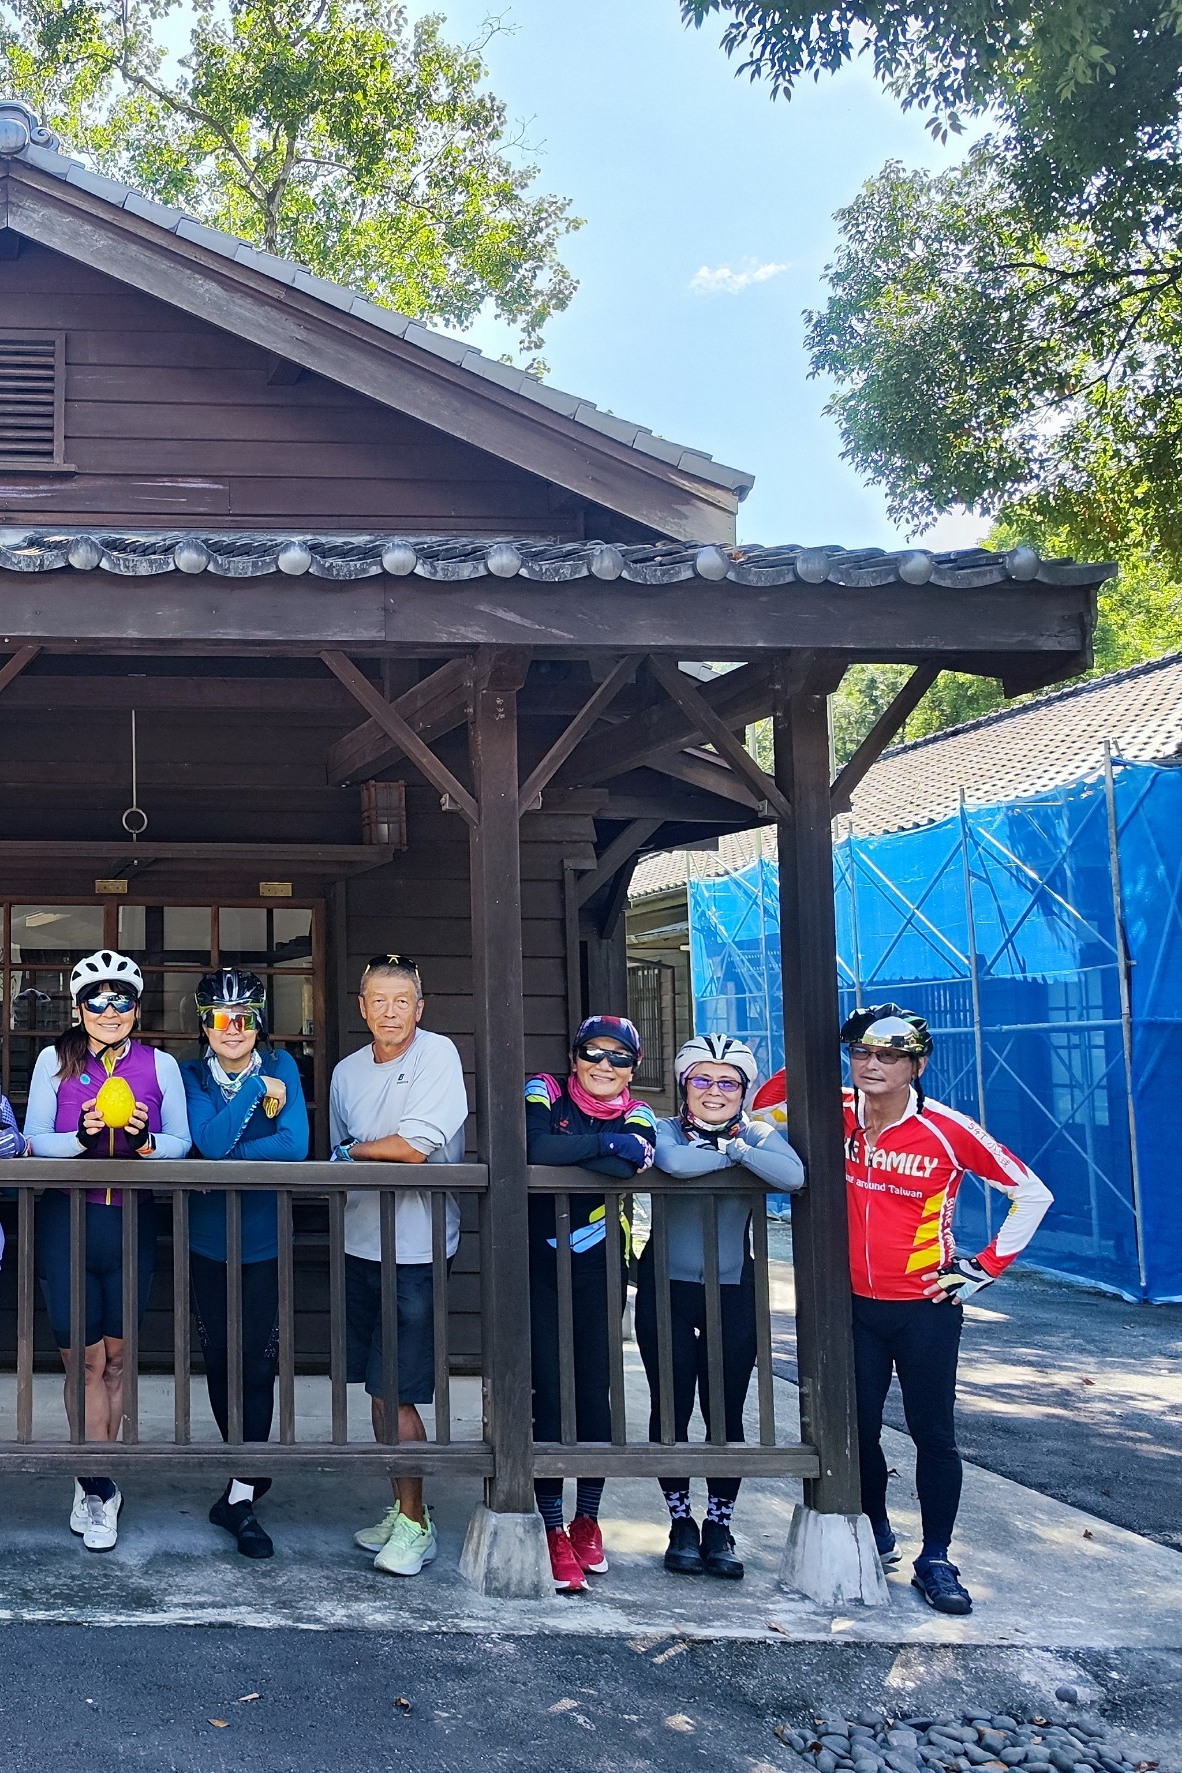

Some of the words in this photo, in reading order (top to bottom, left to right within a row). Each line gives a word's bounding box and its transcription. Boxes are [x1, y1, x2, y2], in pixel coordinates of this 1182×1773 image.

[864, 1145, 939, 1178] FAMILY
[856, 1178, 886, 1192] around
[887, 1184, 923, 1198] Taiwan
